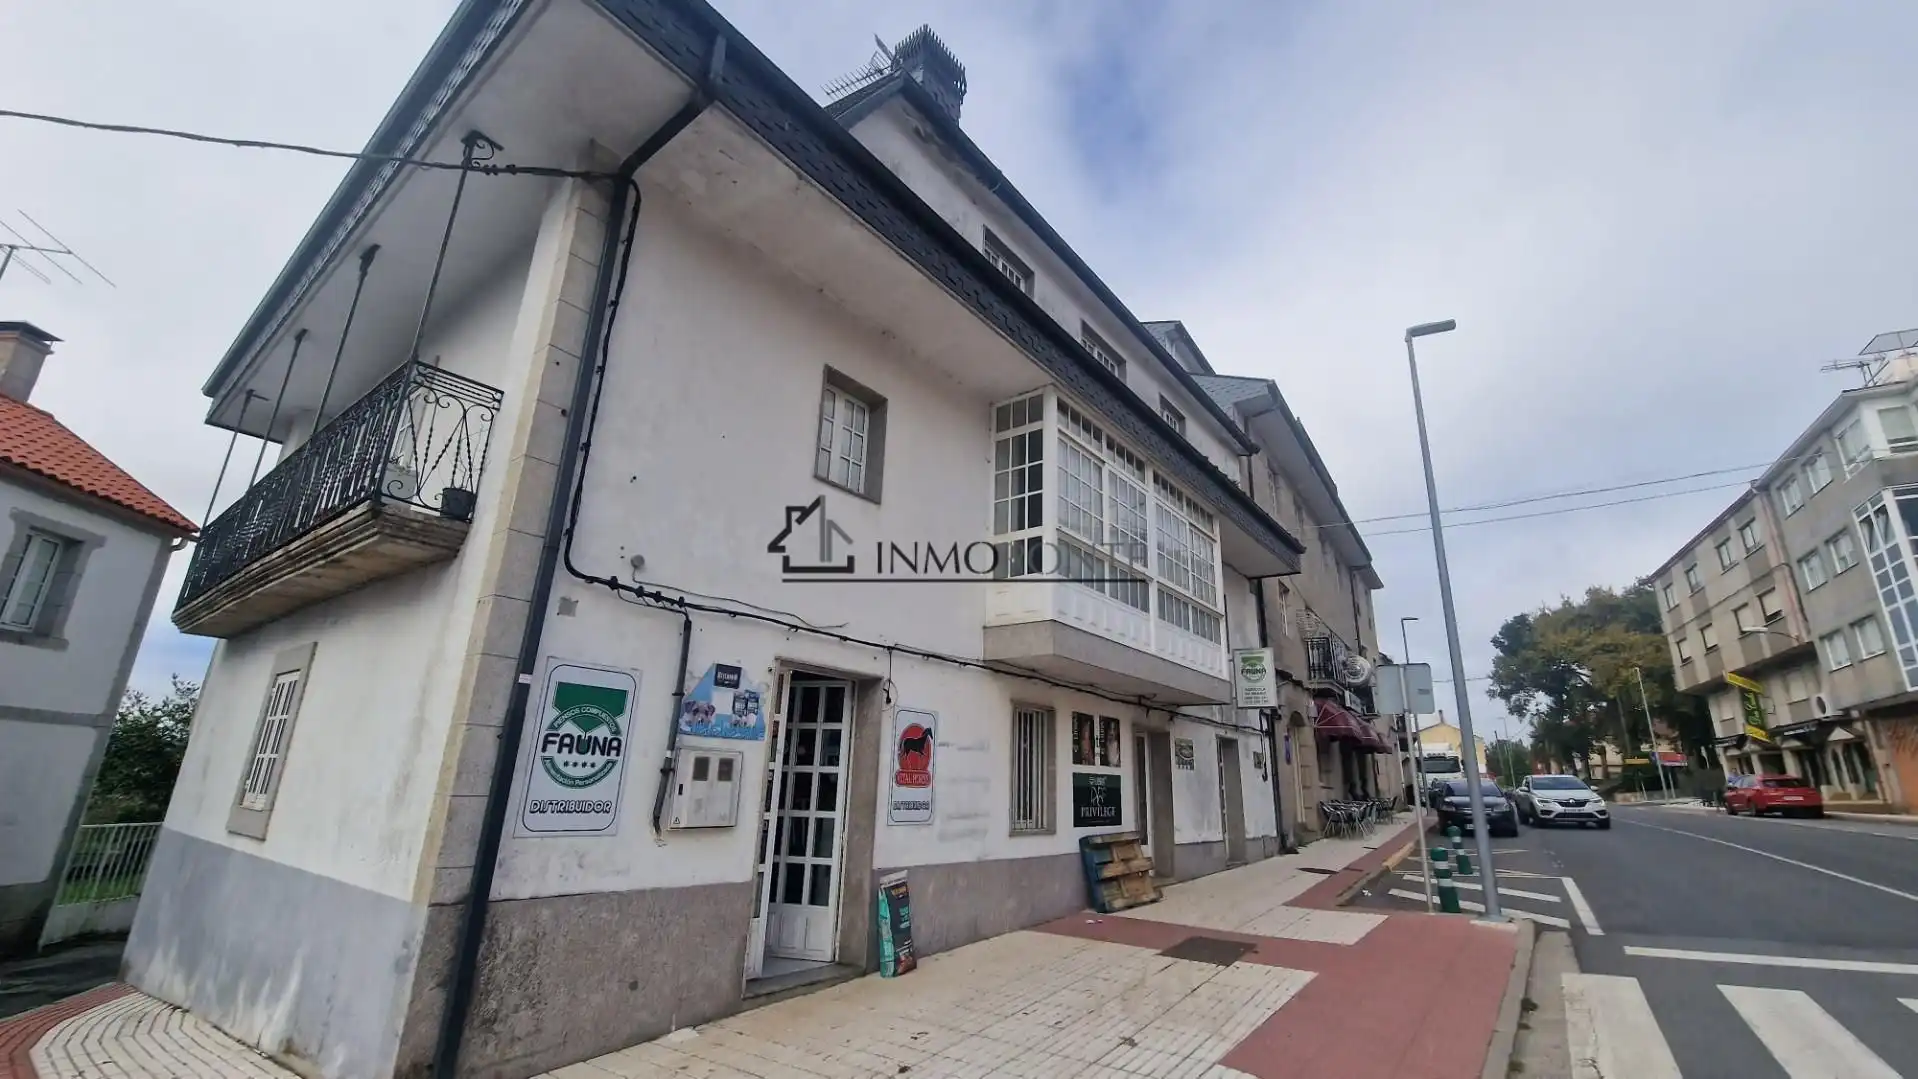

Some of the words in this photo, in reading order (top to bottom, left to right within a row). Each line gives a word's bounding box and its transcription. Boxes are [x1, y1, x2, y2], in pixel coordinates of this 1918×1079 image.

[553, 706, 580, 728] PIENSOS
[581, 706, 618, 734] COMPUESTOS
[541, 732, 622, 757] FAUNA
[529, 799, 613, 814] DISTRIBUIDOR
